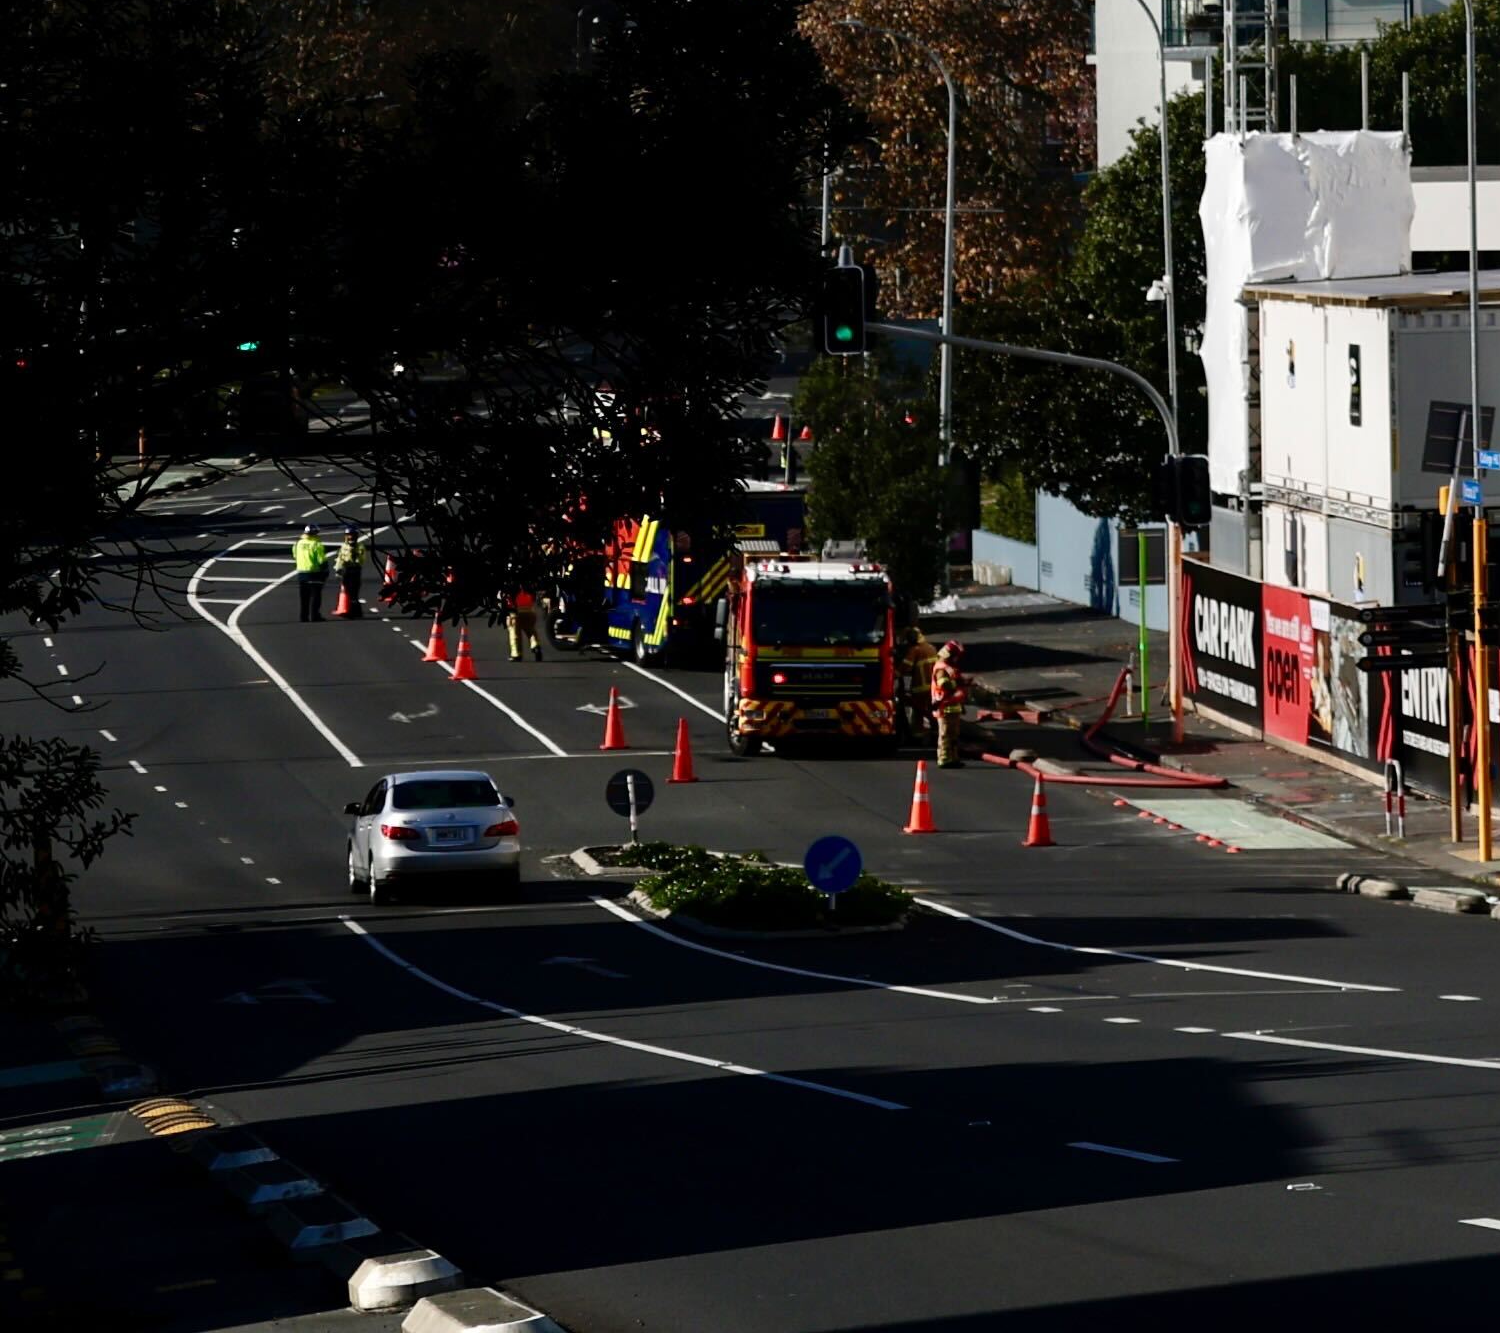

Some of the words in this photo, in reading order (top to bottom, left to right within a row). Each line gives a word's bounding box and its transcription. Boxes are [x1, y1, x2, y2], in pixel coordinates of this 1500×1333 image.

[1194, 594, 1220, 658] CAR
[1220, 600, 1256, 669] PARK
[1266, 646, 1300, 715] open
